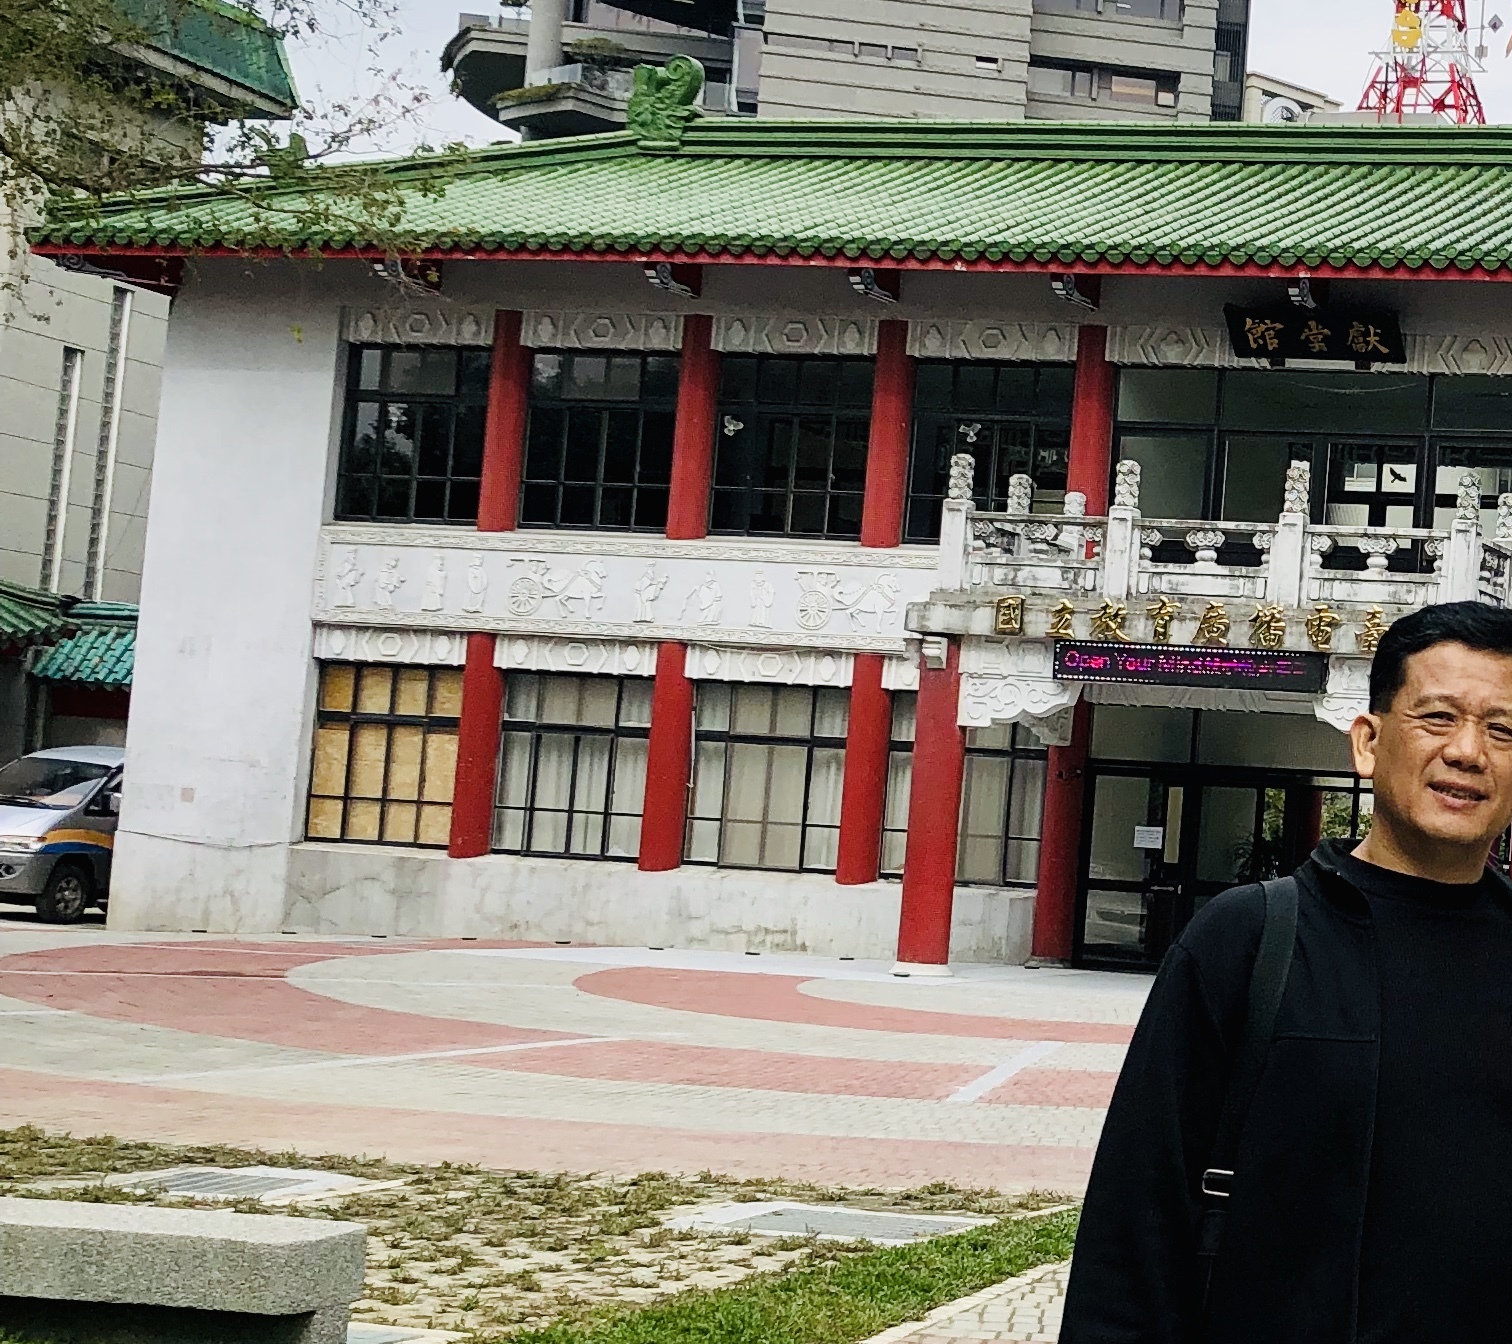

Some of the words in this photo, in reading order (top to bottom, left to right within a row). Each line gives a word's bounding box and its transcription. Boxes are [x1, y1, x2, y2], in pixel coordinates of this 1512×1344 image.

[994, 594, 1391, 651] 國立教育廣播電臺
[1064, 649, 1112, 672] Open
[1113, 651, 1156, 672] Your
